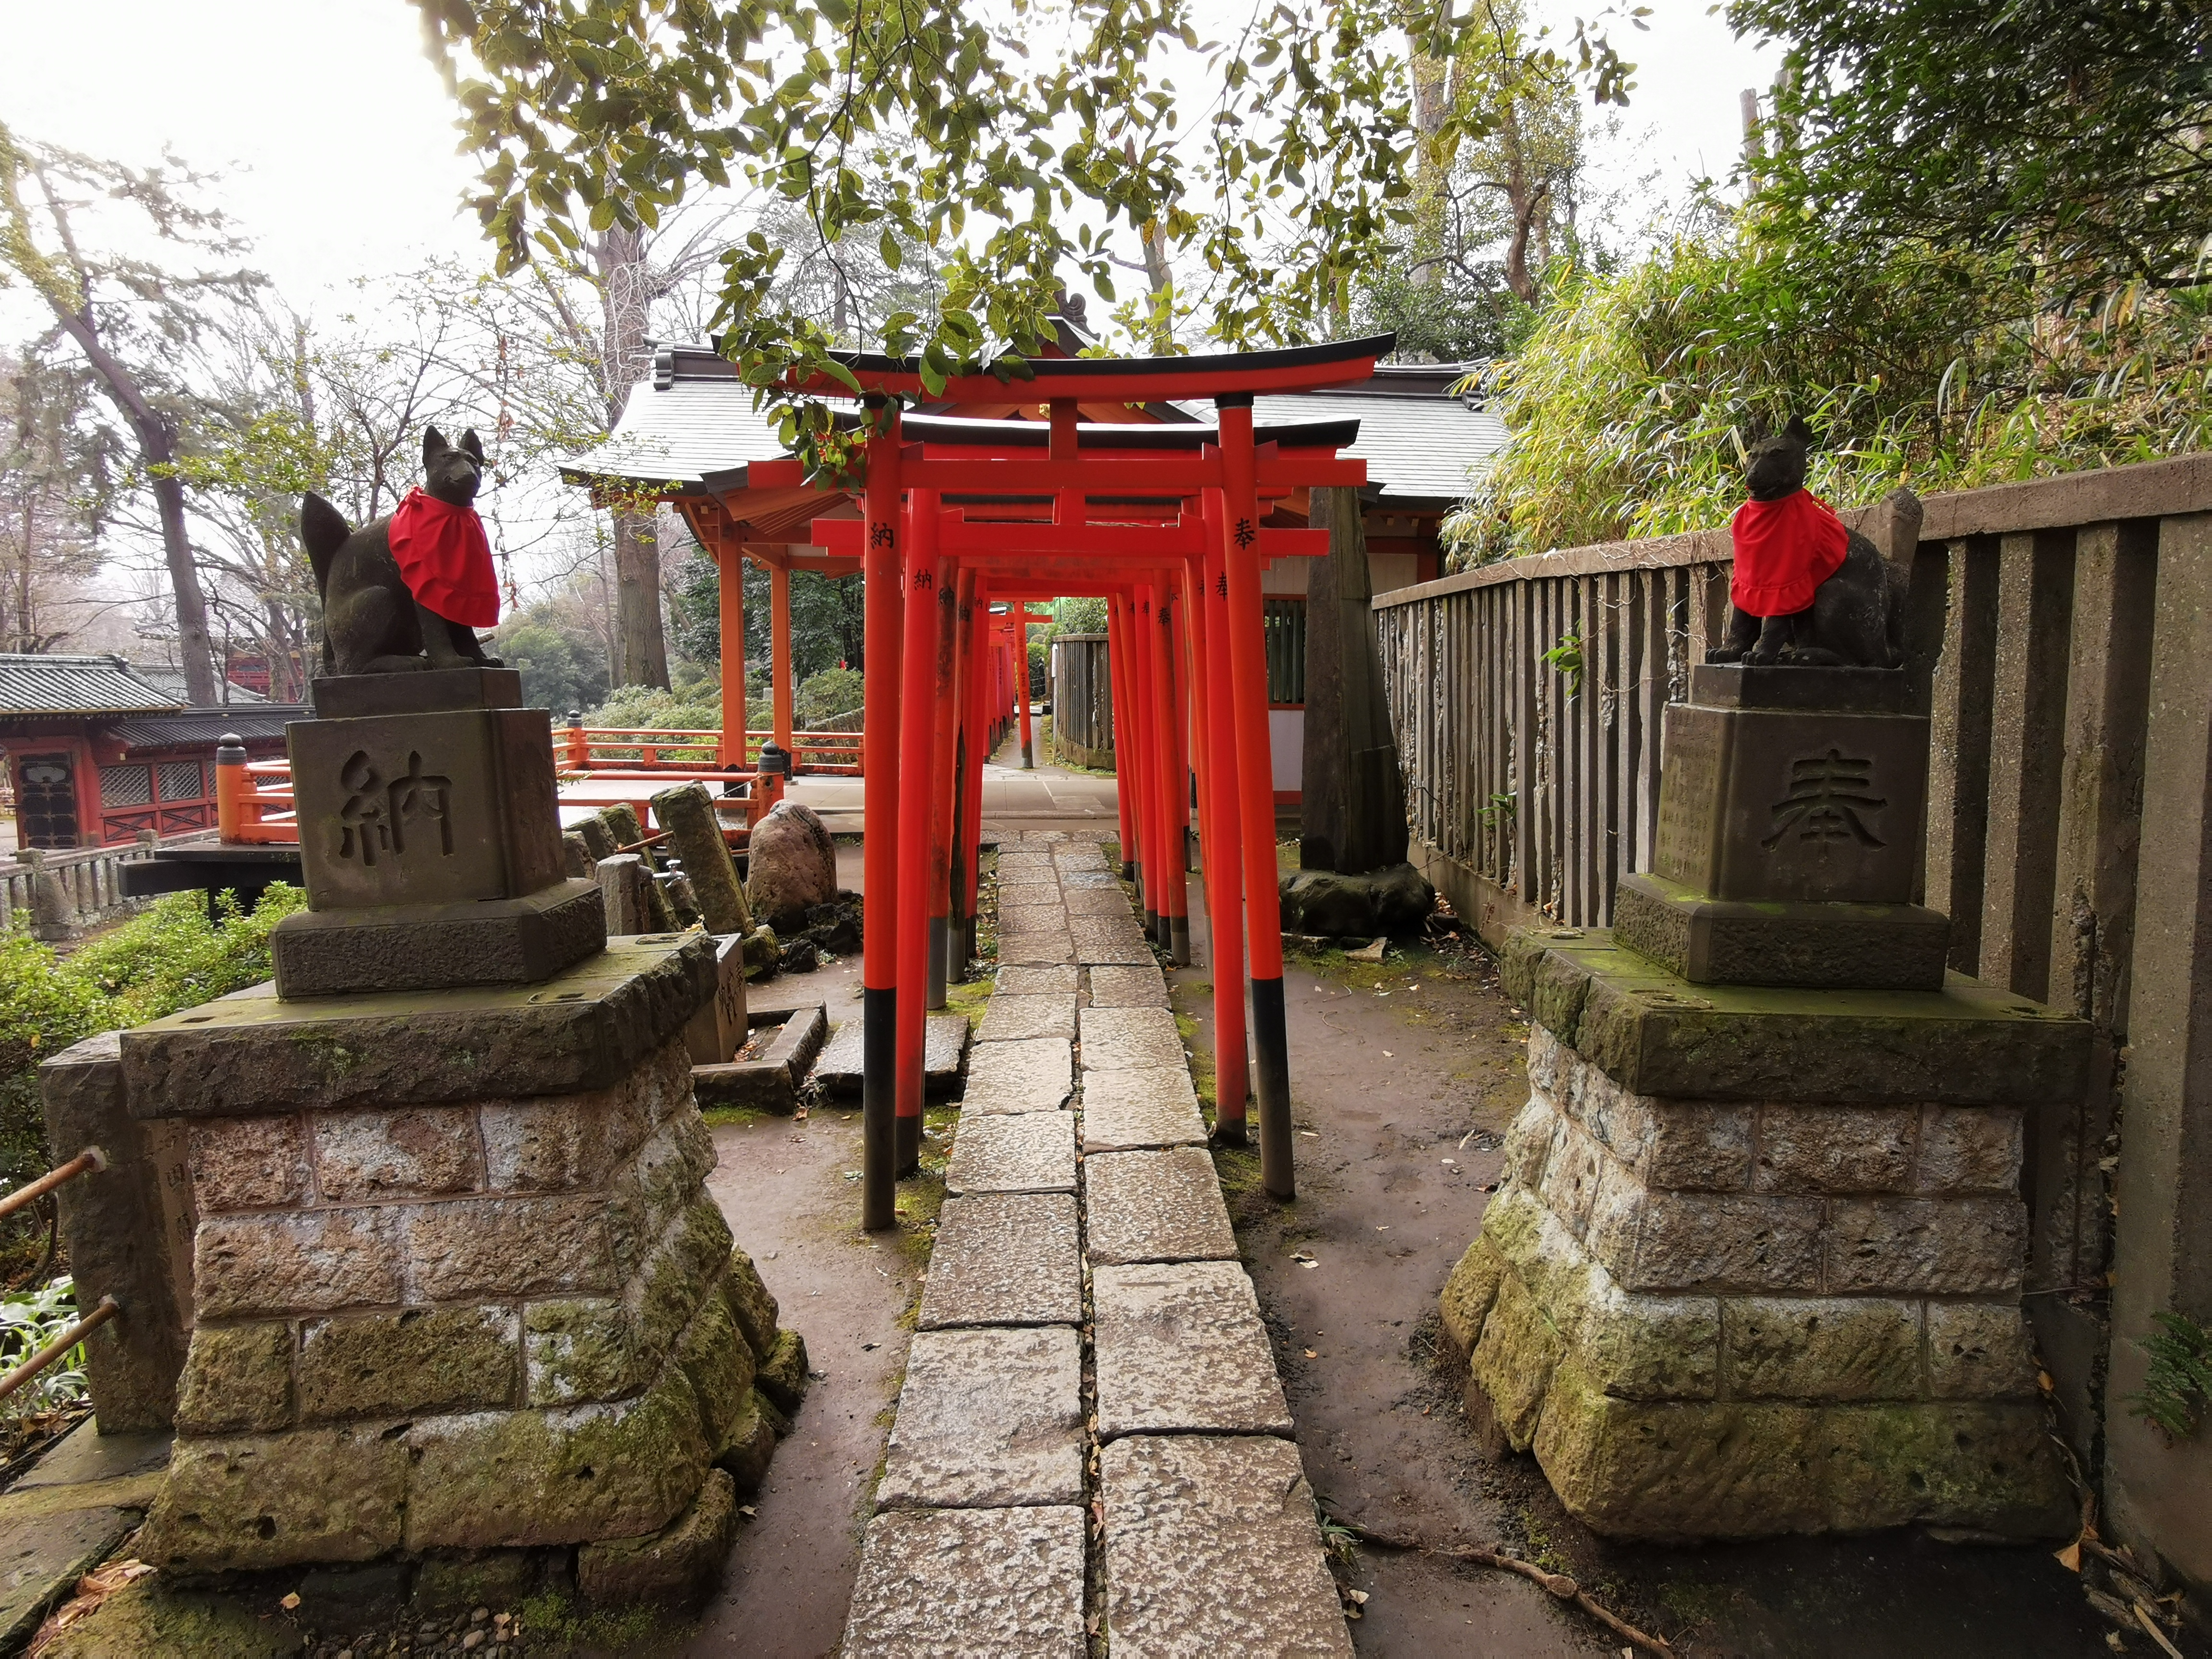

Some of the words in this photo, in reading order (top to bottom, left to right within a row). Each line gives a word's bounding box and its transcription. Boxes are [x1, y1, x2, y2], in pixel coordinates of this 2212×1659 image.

[870, 522, 894, 550] 納
[1234, 517, 1256, 551] 奉
[914, 568, 932, 591] 納
[1158, 606, 1170, 626] 奉
[339, 750, 453, 867] 納
[1760, 748, 1888, 864] 奉
